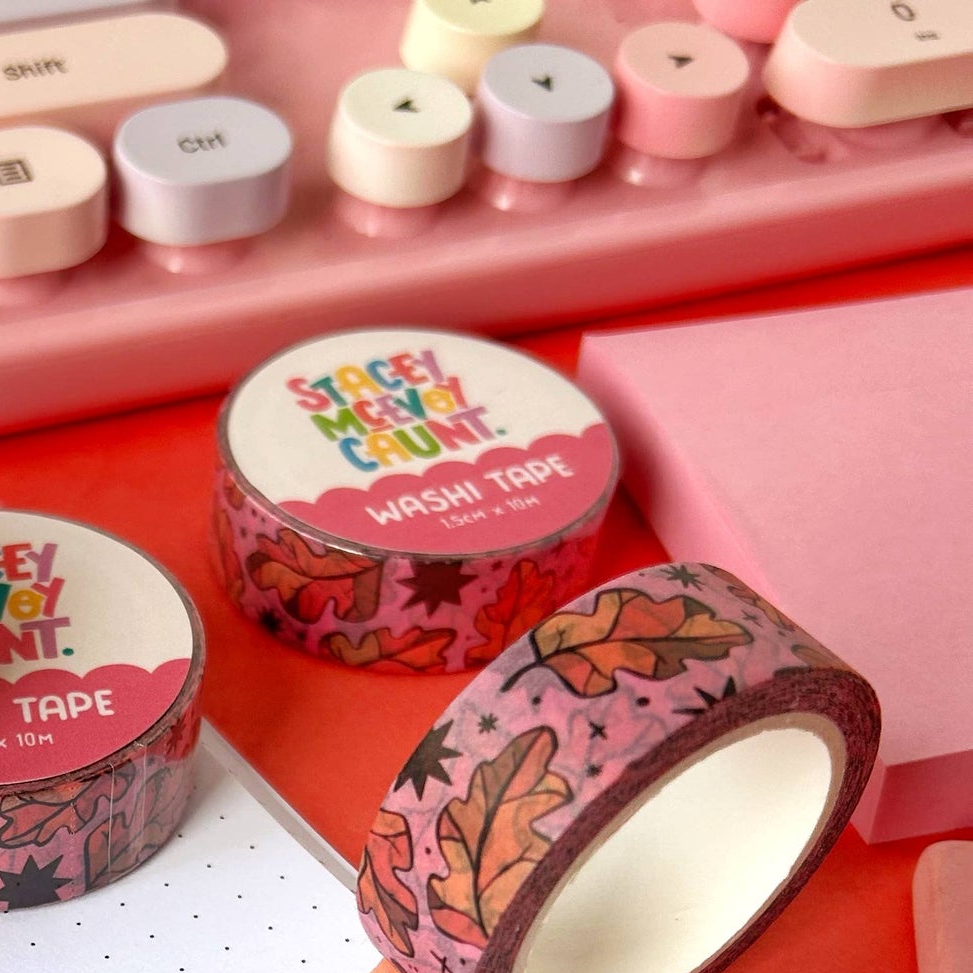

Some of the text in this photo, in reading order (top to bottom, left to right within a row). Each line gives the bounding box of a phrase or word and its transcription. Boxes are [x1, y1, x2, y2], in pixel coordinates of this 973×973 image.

[1, 57, 69, 82] Shift
[177, 131, 227, 154] Ctrl
[285, 350, 446, 412] STACEY
[364, 453, 575, 526] WASHI TAPE
[12, 690, 115, 724] TAPE
